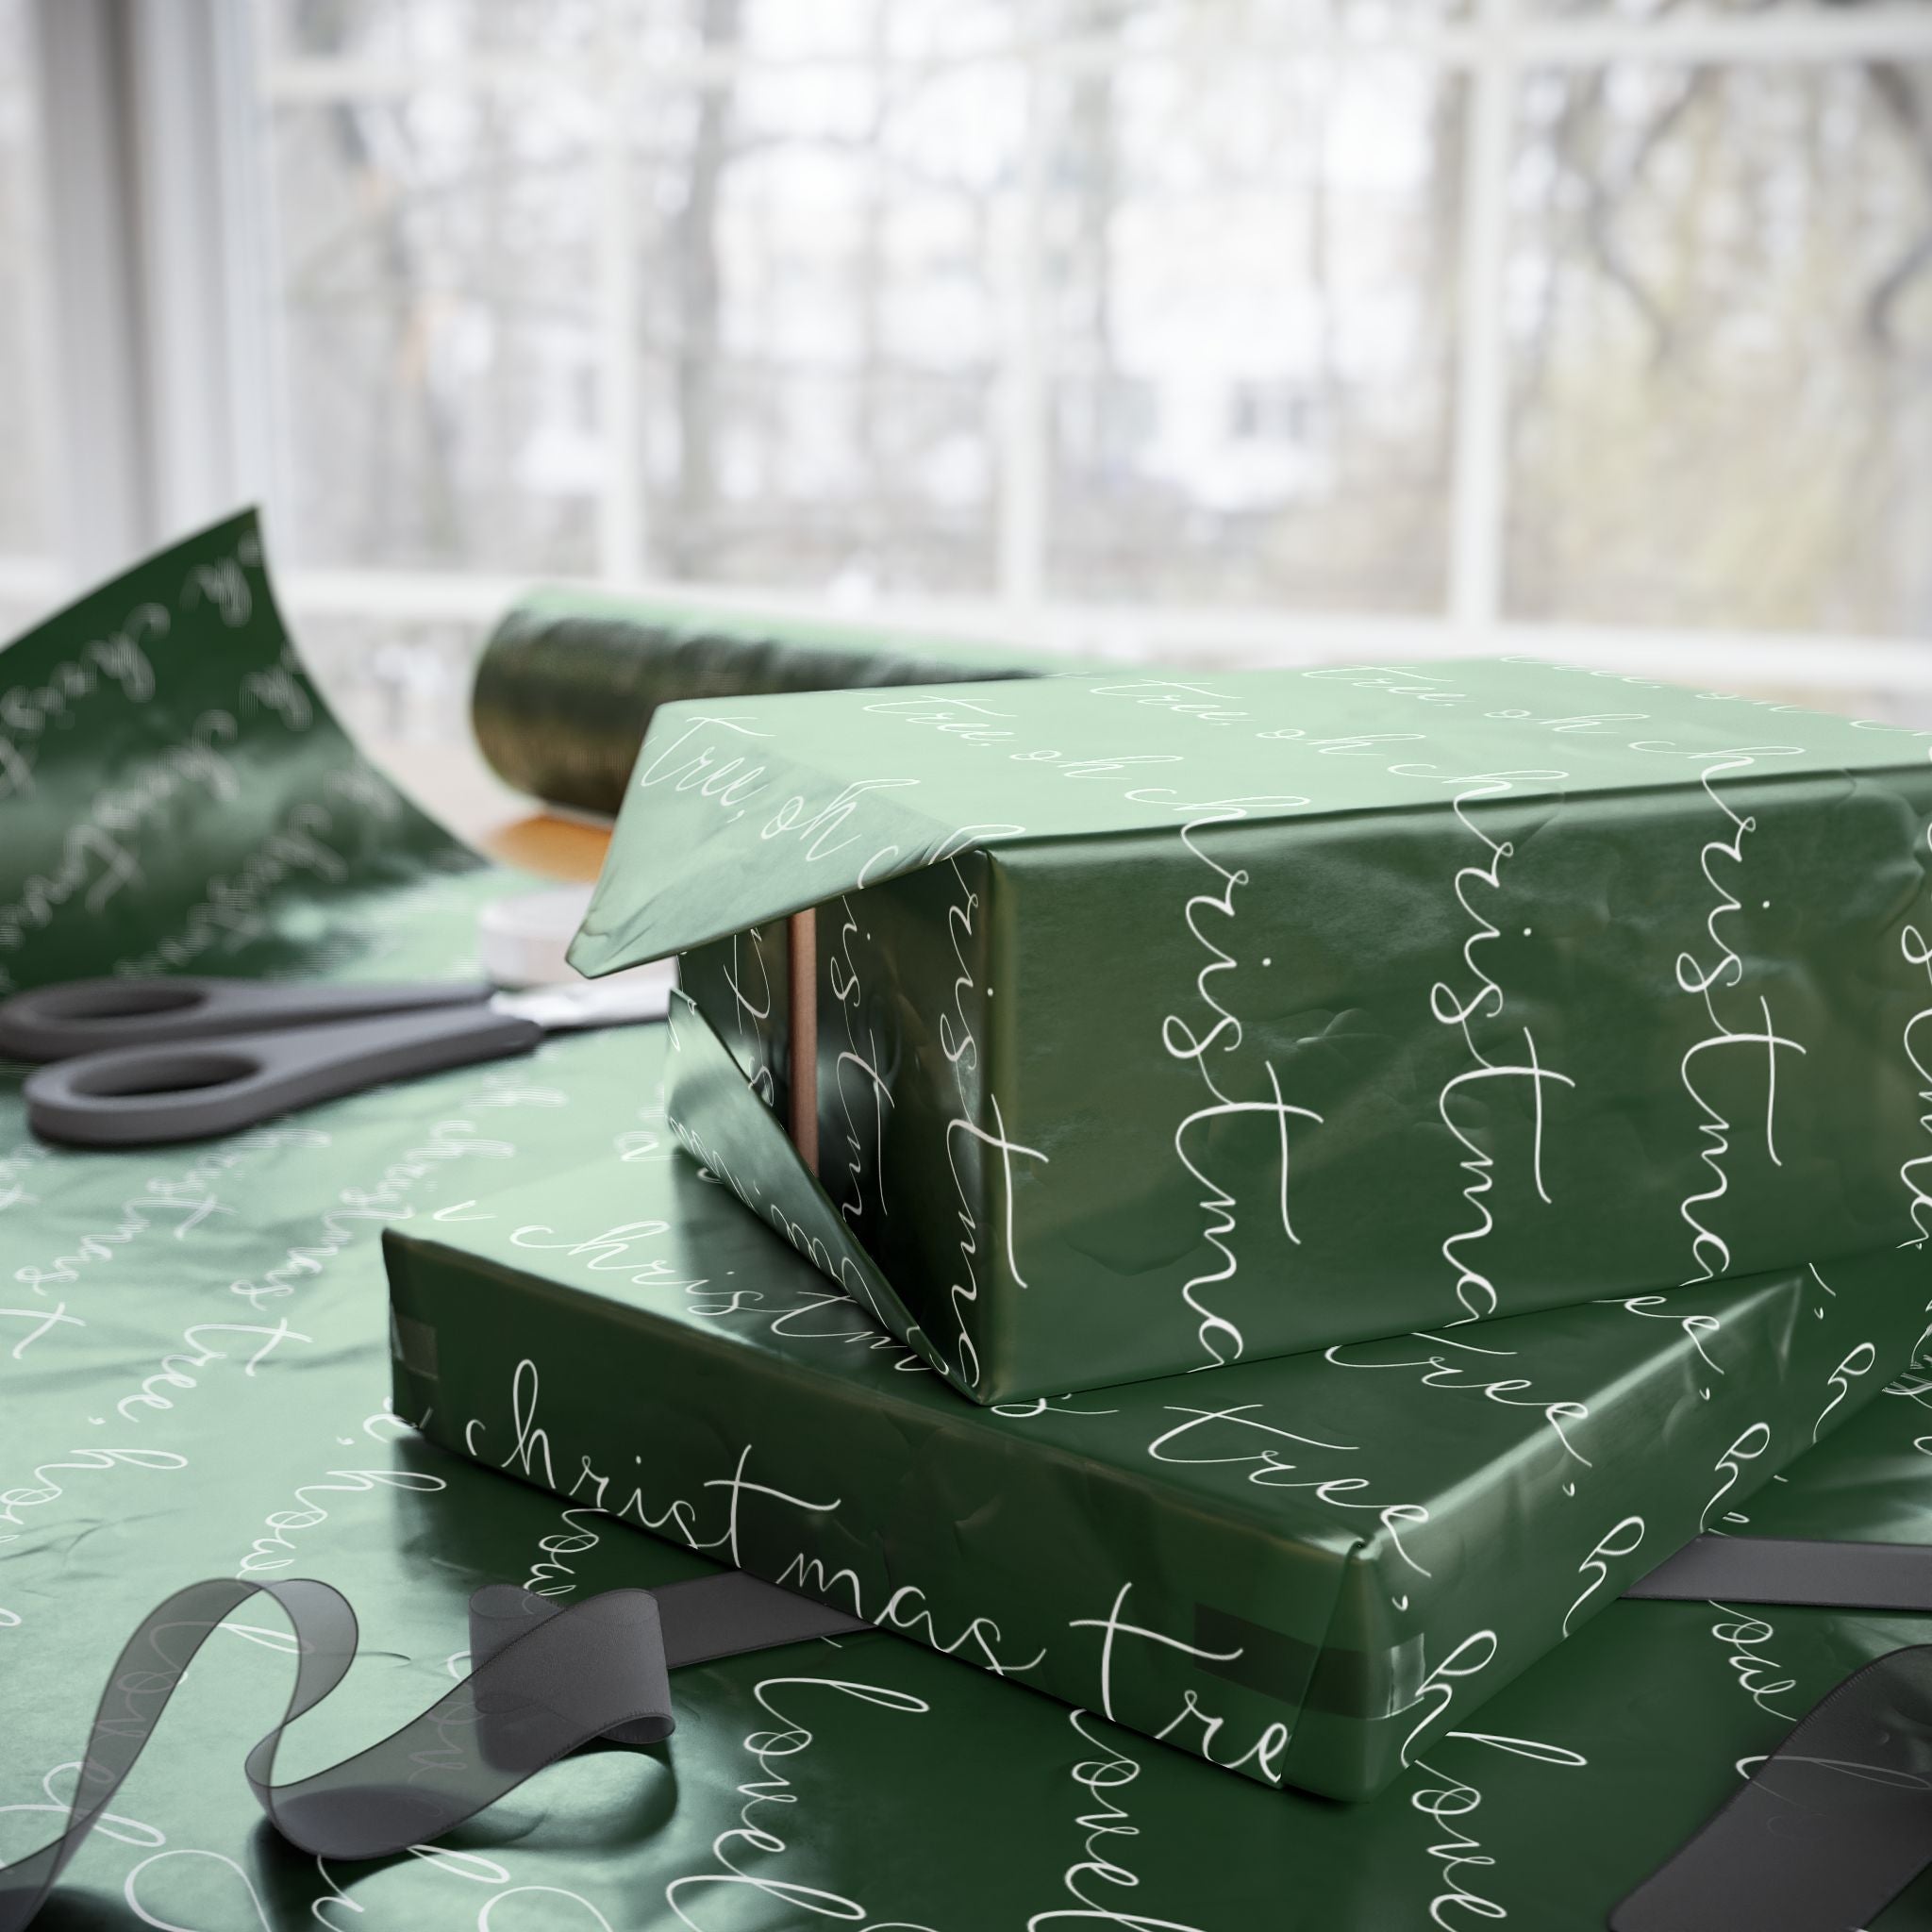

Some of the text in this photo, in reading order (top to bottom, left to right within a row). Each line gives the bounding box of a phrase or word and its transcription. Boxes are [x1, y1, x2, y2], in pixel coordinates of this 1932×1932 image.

[641, 715, 777, 824] tree,
[759, 778, 922, 862] oh
[862, 694, 1019, 747] tree,
[1009, 749, 1185, 780] oh
[1124, 787, 1324, 1374] christma
[1090, 678, 1576, 1329] tree, oh christma
[1301, 664, 1477, 708] tree,
[1484, 708, 1651, 734] oh
[1628, 741, 1807, 1288] christma
[88, 1317, 314, 1426] tree,
[235, 1469, 447, 1584] how
[464, 1358, 1294, 1783] christmas tre
[1148, 1404, 1432, 1611] tree,
[665, 1676, 930, 1932] lovel
[1409, 1730, 1590, 1932] love
